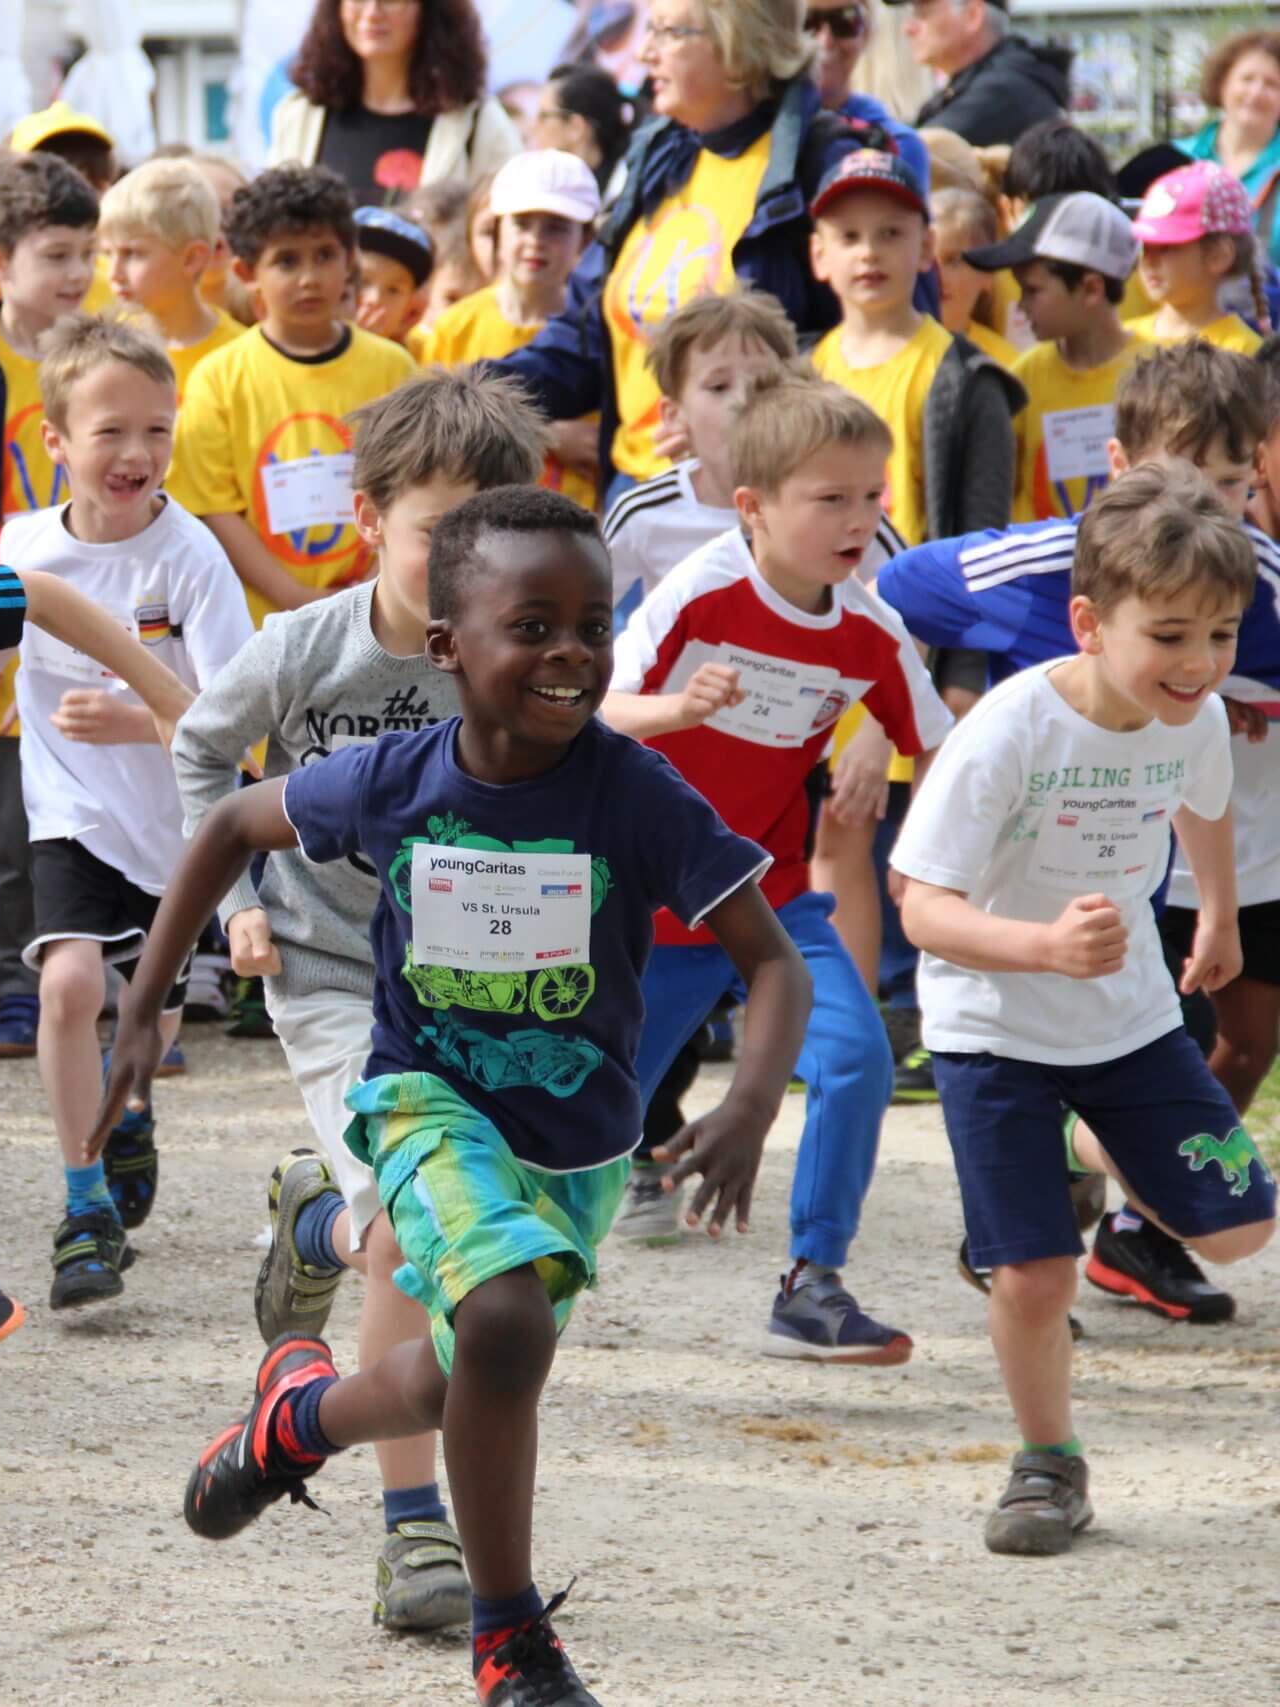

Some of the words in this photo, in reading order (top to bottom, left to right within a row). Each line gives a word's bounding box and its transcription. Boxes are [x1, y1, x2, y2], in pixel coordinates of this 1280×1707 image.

[729, 655, 797, 678] youngCaritas
[382, 686, 430, 716] the
[752, 704, 771, 717] 24
[1028, 767, 1132, 793] SAILING
[1144, 759, 1186, 785] TEAM
[1062, 798, 1138, 812] youngCaritas
[1098, 845, 1117, 859] 26
[430, 857, 527, 876] youngCaritas
[462, 902, 478, 914] VS
[482, 903, 498, 915] St.
[501, 905, 541, 917] Ursula
[489, 920, 513, 936] 28
